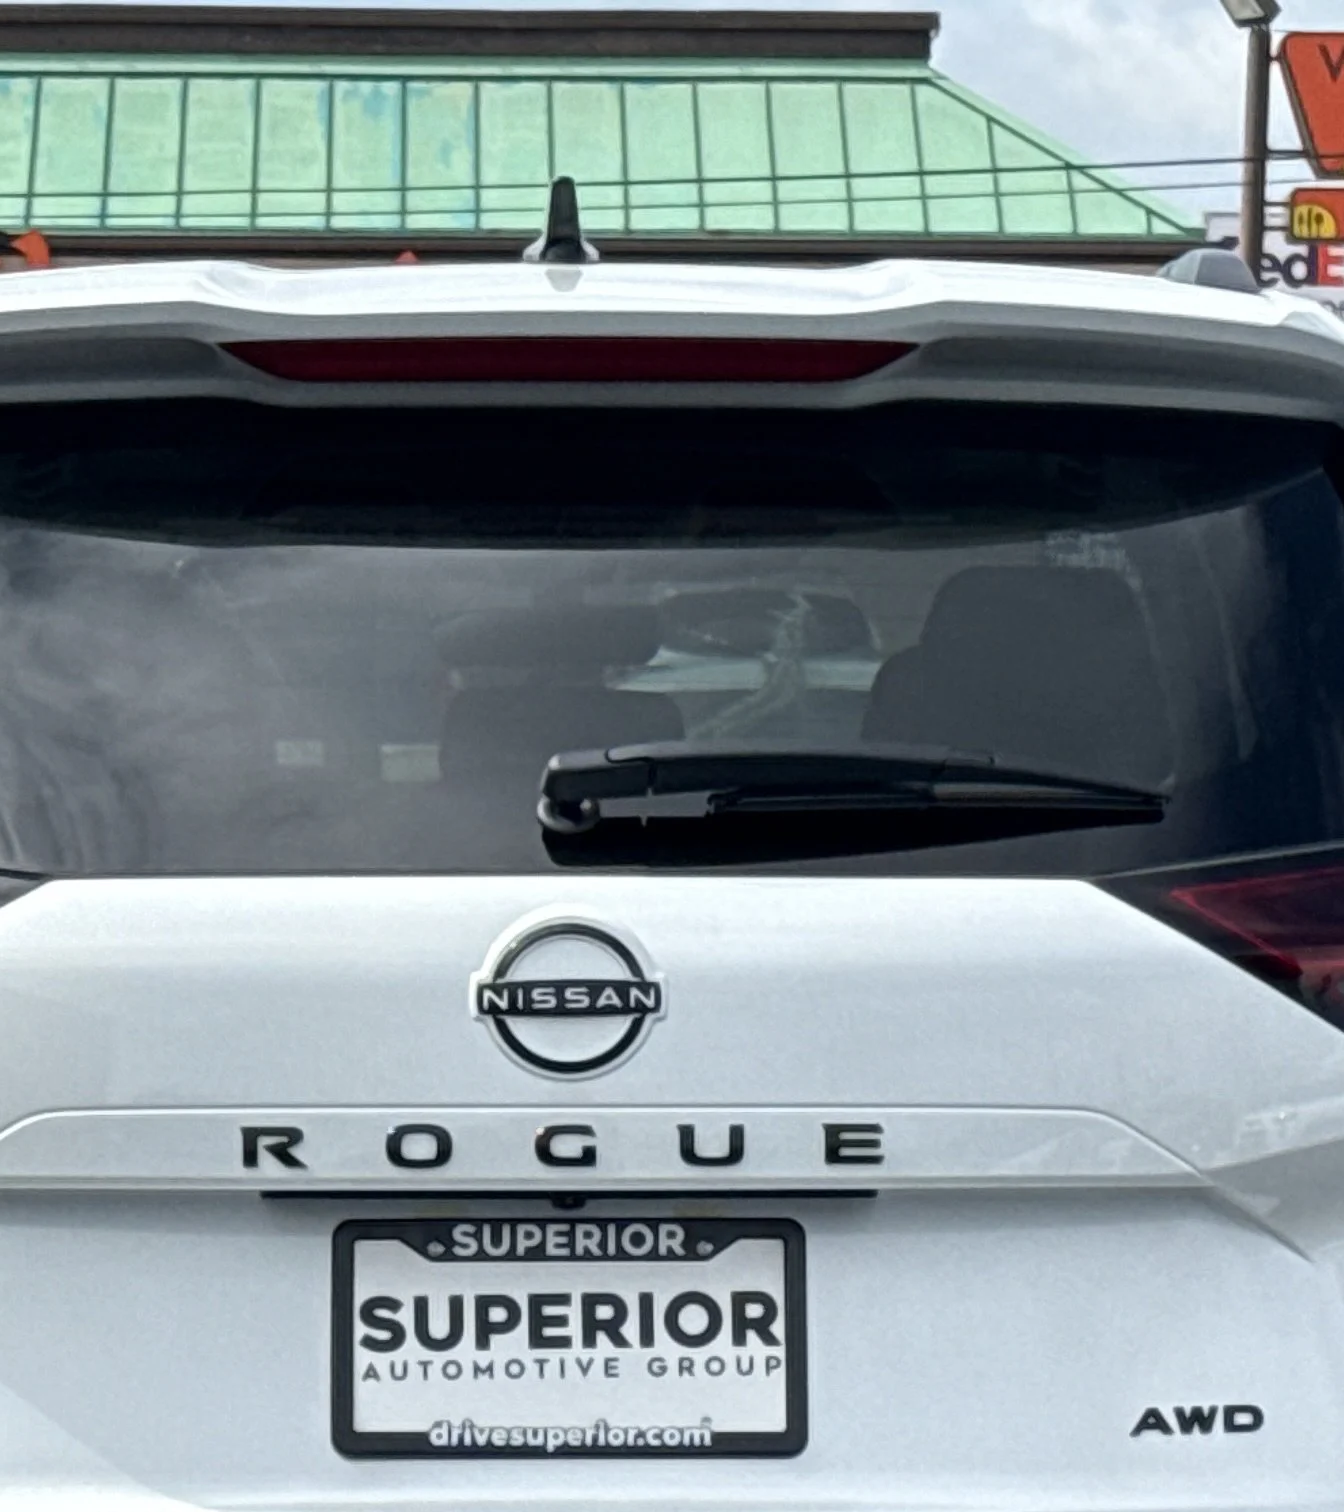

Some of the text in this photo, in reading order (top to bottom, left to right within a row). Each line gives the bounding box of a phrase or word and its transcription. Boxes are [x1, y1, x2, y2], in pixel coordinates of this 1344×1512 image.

[482, 986, 656, 1011] NISSAN
[239, 1122, 886, 1170] ROGUE
[451, 1223, 686, 1257] SUPERIOR
[358, 1290, 784, 1353] SUPERIOR
[361, 1354, 784, 1382] AUTOMOTIVE GROUP
[428, 1417, 714, 1453] drivesuperior.com
[1129, 1404, 1265, 1438] AWD
